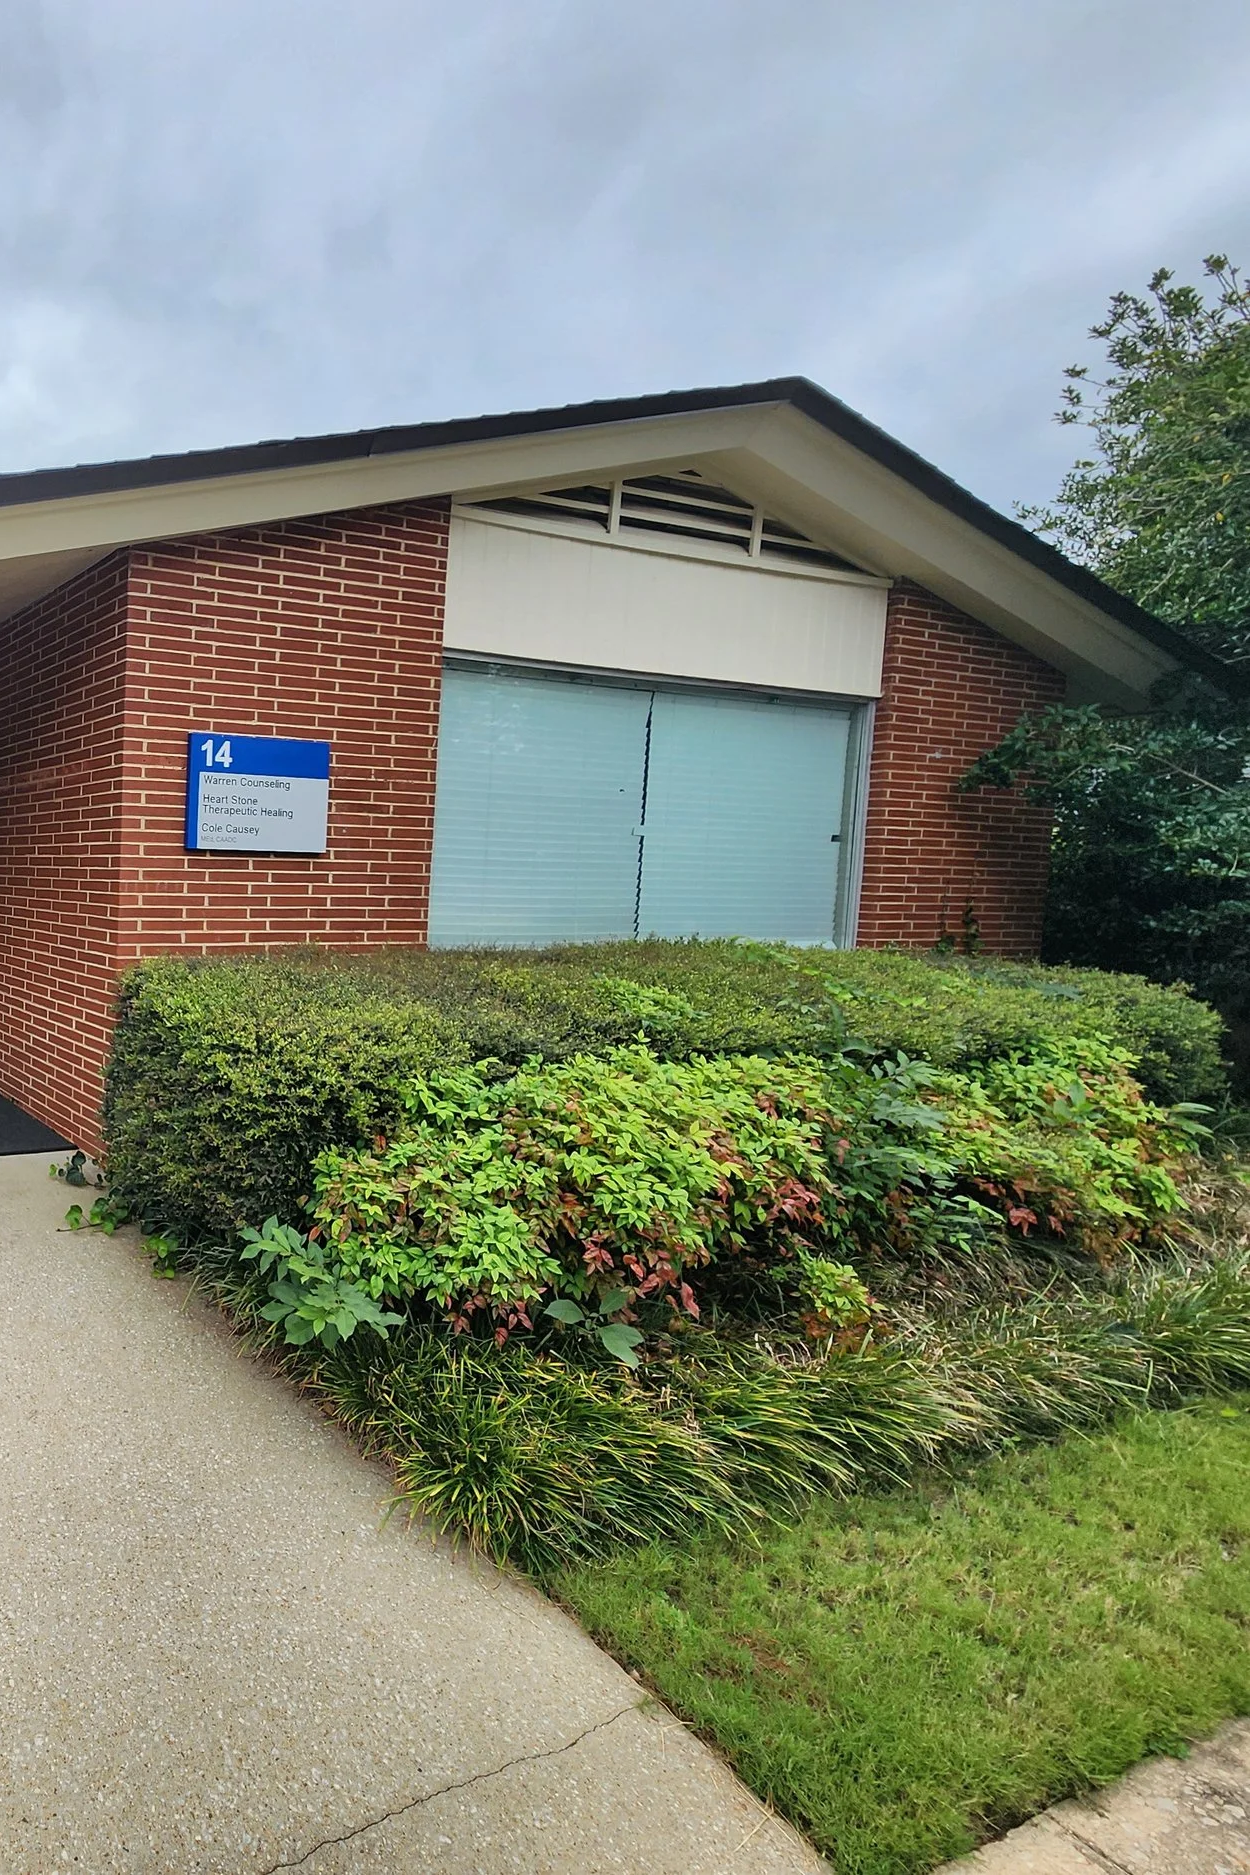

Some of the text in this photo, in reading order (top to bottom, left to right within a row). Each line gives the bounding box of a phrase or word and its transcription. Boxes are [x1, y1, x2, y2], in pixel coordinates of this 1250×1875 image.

[201, 739, 233, 768] 14
[203, 775, 291, 791] Warren Counseling
[203, 793, 258, 805] Heart Stone
[203, 804, 294, 819] Therapeutic Healing
[201, 822, 260, 836] Cole Causey
